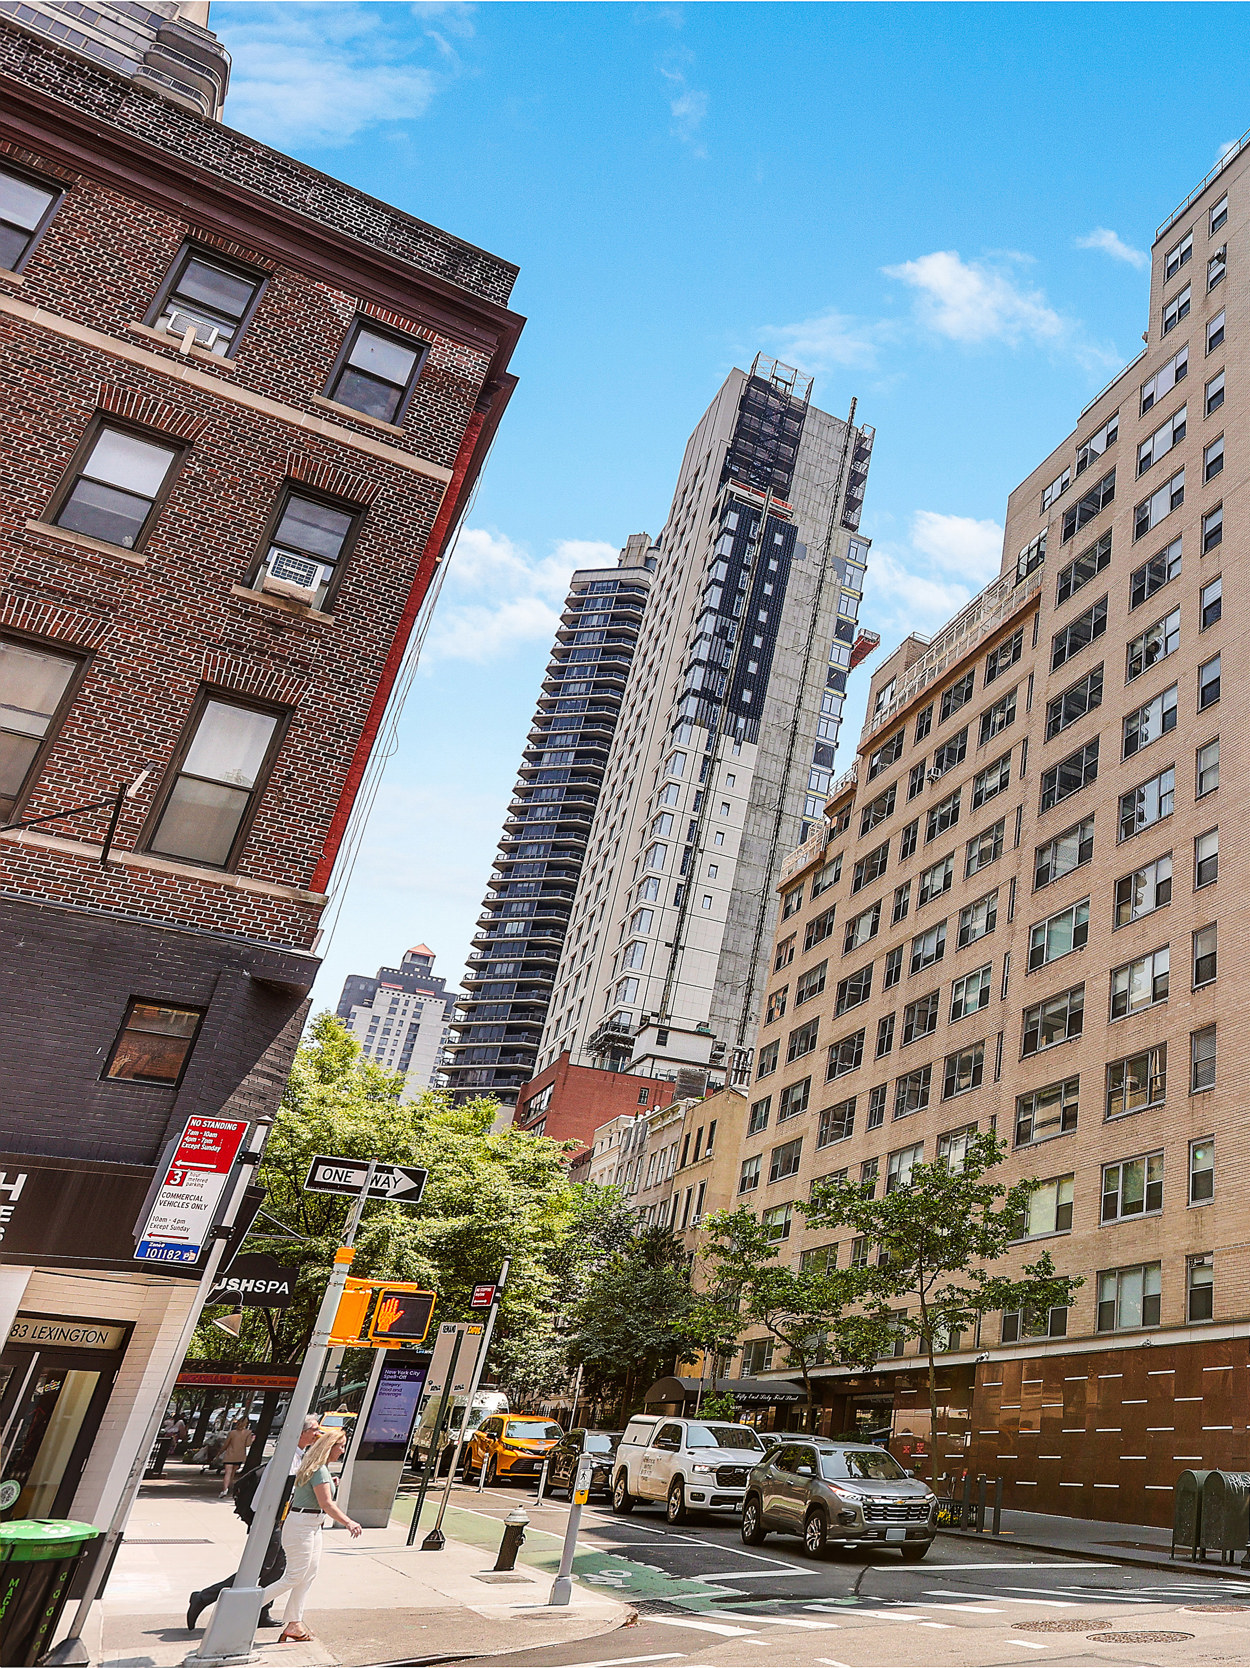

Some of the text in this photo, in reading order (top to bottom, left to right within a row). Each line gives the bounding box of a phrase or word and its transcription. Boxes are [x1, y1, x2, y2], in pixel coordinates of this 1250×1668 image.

[190, 1118, 238, 1131] NO STANDING
[181, 1142, 222, 1153] Except Sunday
[169, 1170, 183, 1185] 3
[322, 1167, 403, 1189] ONE WAY
[161, 1191, 204, 1202] COMMERCIAL
[159, 1200, 208, 1211] VEHICLES ONLY
[152, 1215, 167, 1223] 10am
[173, 1217, 186, 1225] 4pm
[149, 1223, 190, 1233] Except Sunday
[145, 1248, 182, 1260] 101182
[31, 1325, 109, 1344] LEXINGTON
